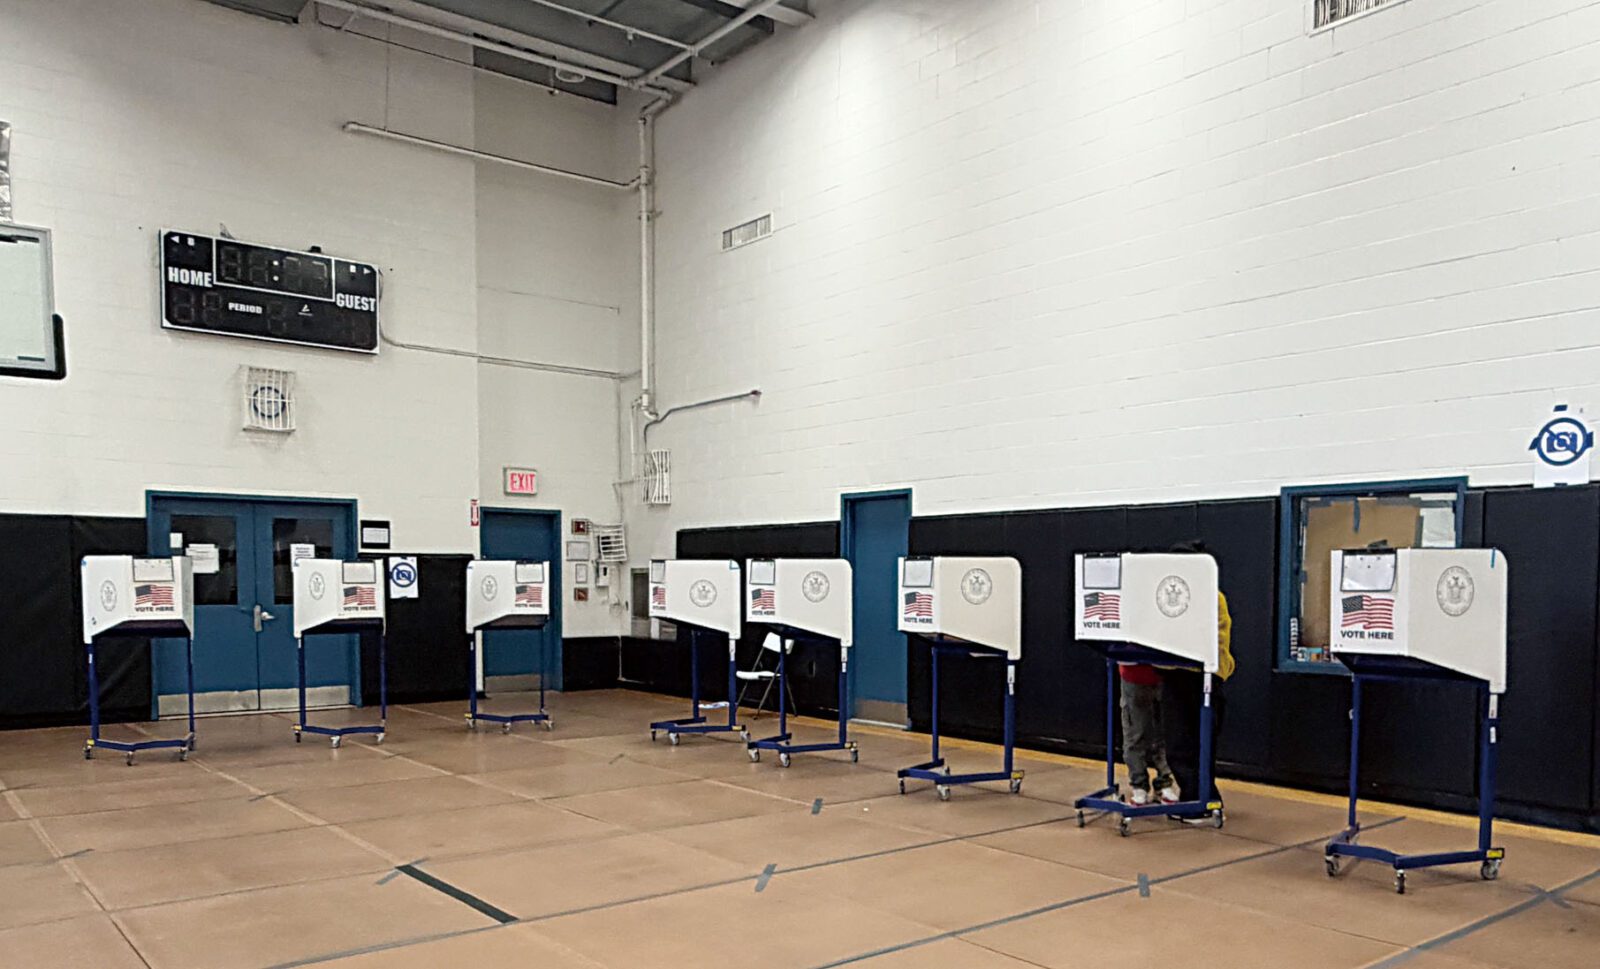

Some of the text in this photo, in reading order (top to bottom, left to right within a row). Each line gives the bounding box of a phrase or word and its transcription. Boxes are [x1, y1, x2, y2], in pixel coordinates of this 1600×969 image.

[168, 267, 213, 288] HOME
[228, 302, 262, 314] PERIOD
[336, 293, 376, 312] GUEST
[510, 473, 536, 492] EXIT
[1083, 621, 1100, 629] VOTE
[1340, 630, 1394, 640] VOTE HERE
